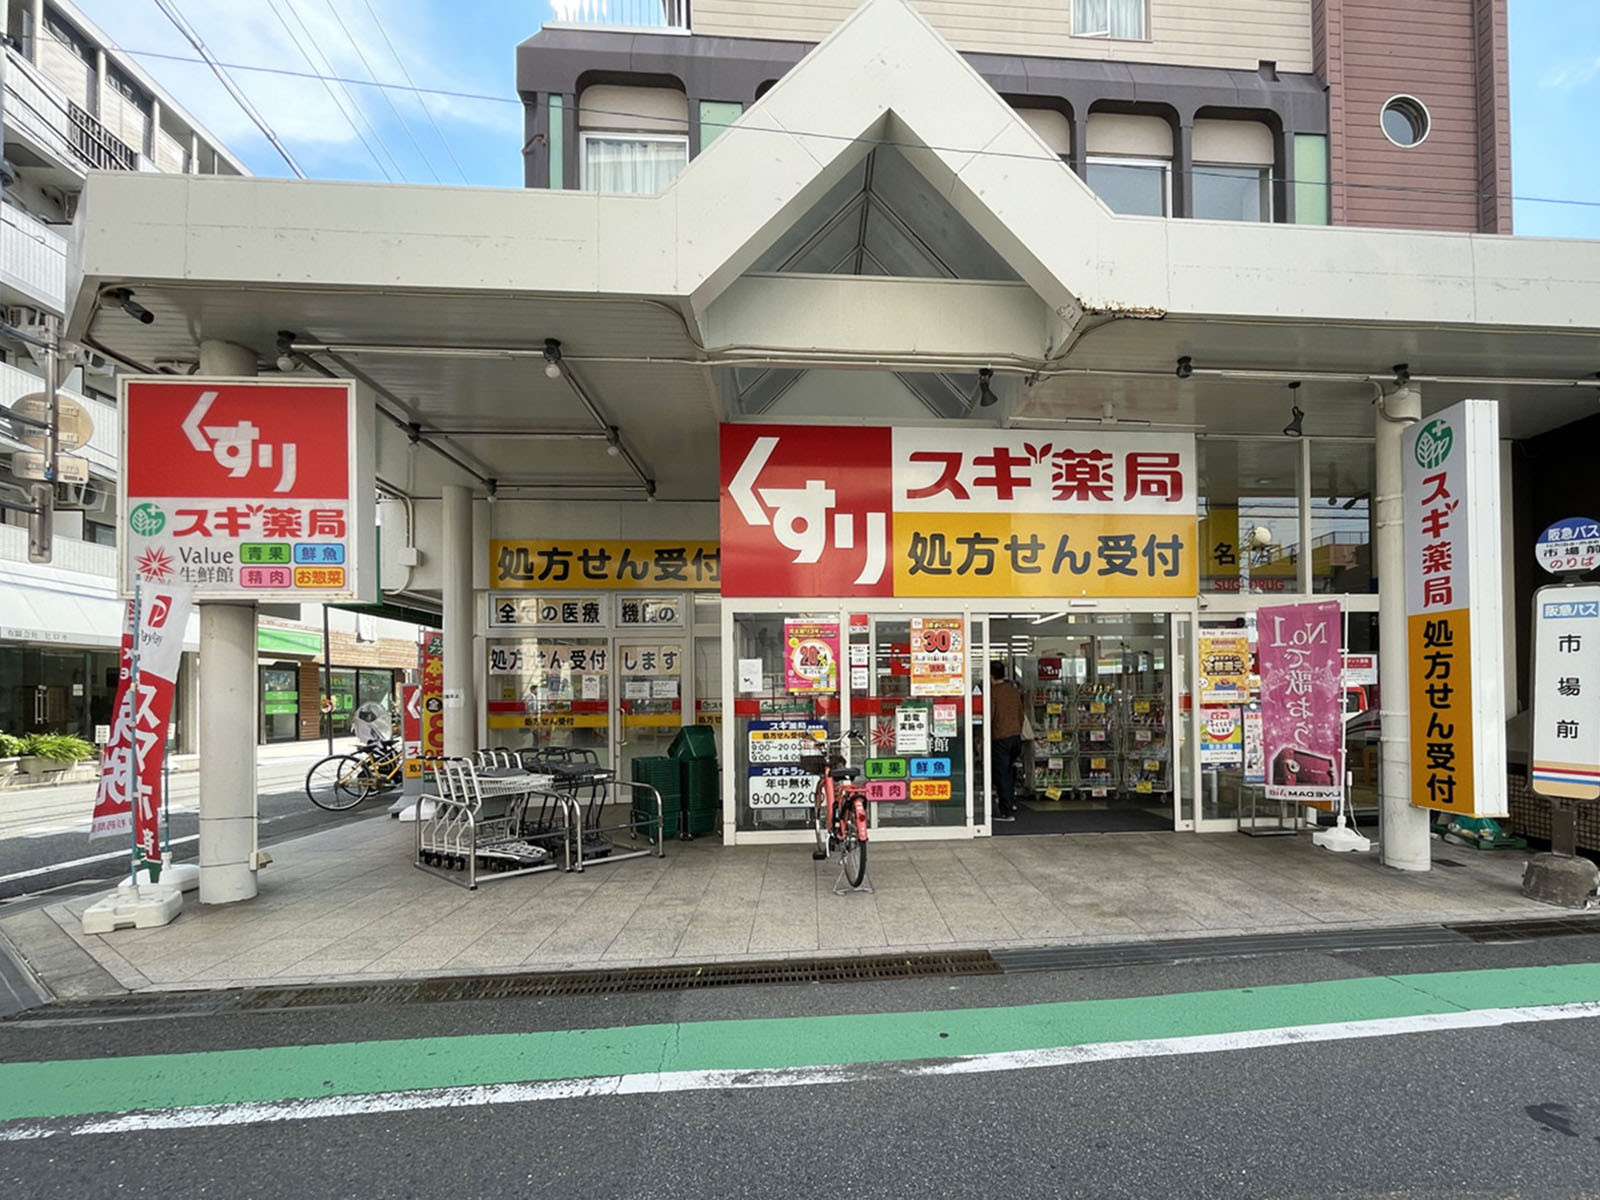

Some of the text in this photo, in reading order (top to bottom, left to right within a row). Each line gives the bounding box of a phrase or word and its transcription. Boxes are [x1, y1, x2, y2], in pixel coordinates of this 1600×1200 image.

[181, 391, 296, 492] くすり
[906, 442, 1184, 502] スギ薬局
[727, 437, 887, 585] くすり
[172, 503, 346, 538] スギ薬局
[1420, 471, 1459, 608] スギ薬局
[1547, 525, 1599, 541] 阪急バス
[179, 547, 234, 565] Value
[248, 547, 284, 560] 青果
[301, 547, 338, 561] 鮮魚
[907, 532, 1184, 577] 処方せん受付
[497, 546, 721, 582] 処方せん受付
[1548, 556, 1594, 569] のりば
[178, 566, 234, 583] 生鮮館
[248, 570, 284, 584] 精肉
[297, 570, 342, 584] お惣菜
[1544, 603, 1597, 617] 阪急バス
[624, 651, 678, 671] します
[1555, 633, 1583, 740] 市場前
[1422, 619, 1457, 806] 処方せん受付
[762, 767, 809, 777] スギドラッ
[871, 762, 901, 775] 青果
[915, 761, 946, 775] 鮮魚
[766, 778, 812, 789] 年中無休
[871, 784, 902, 798] 精肉
[911, 784, 950, 797] お惣菜
